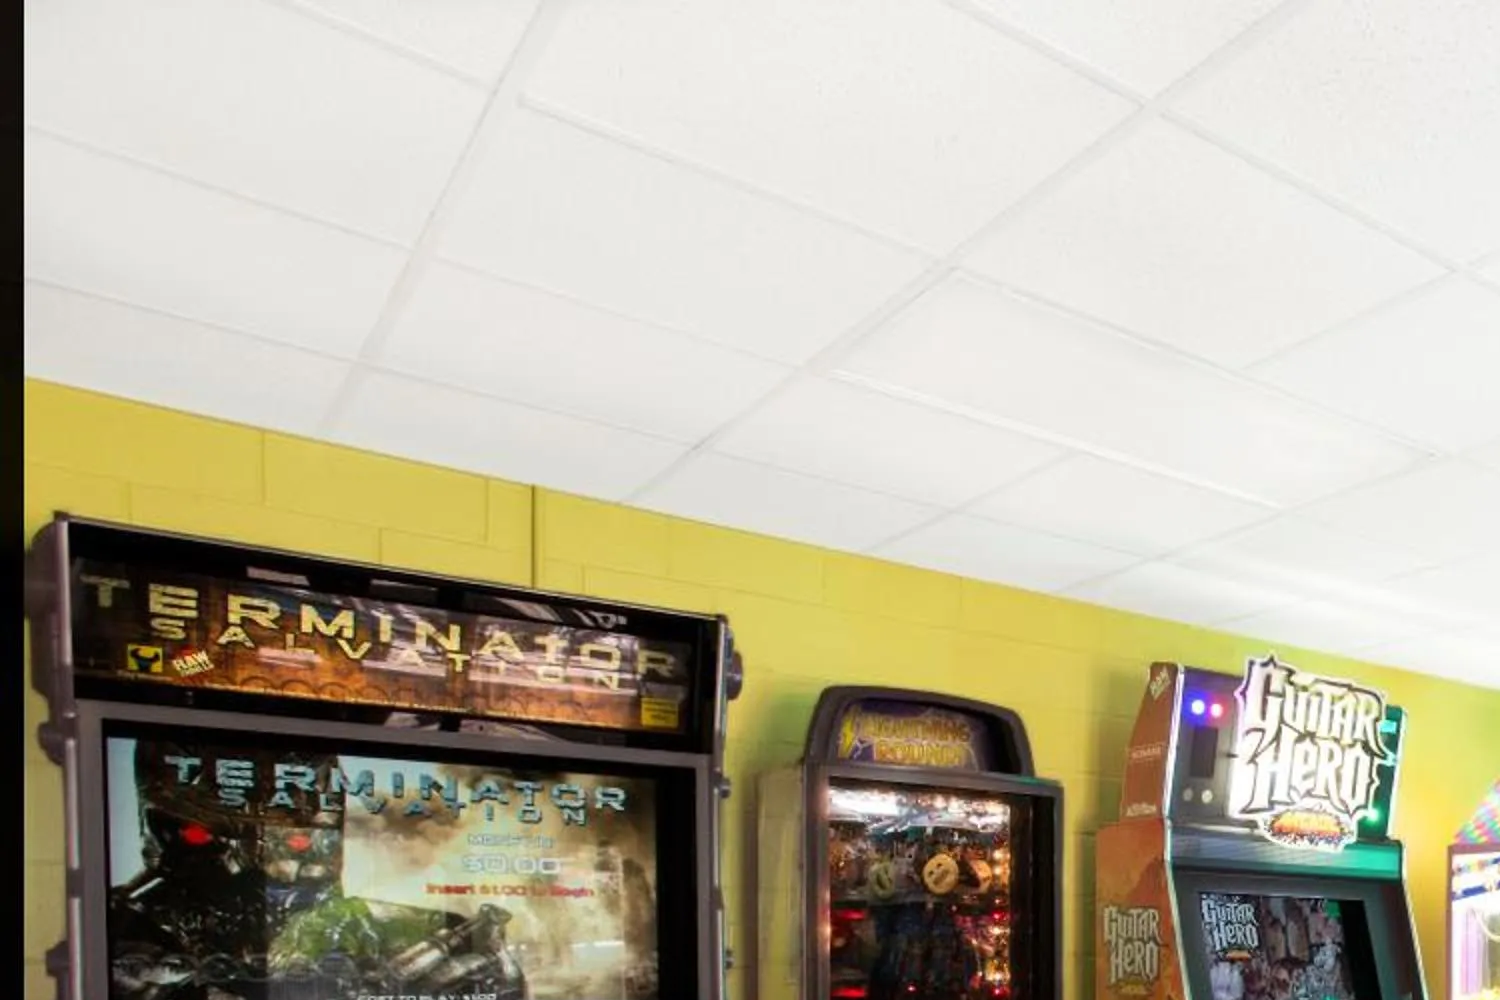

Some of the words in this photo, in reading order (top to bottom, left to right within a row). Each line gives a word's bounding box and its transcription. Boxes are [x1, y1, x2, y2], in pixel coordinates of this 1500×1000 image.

[80, 573, 677, 677] TERMINATOR
[150, 617, 621, 692] SALVATION
[163, 754, 627, 812] TERMINATOR
[218, 787, 587, 826] SALVATION
